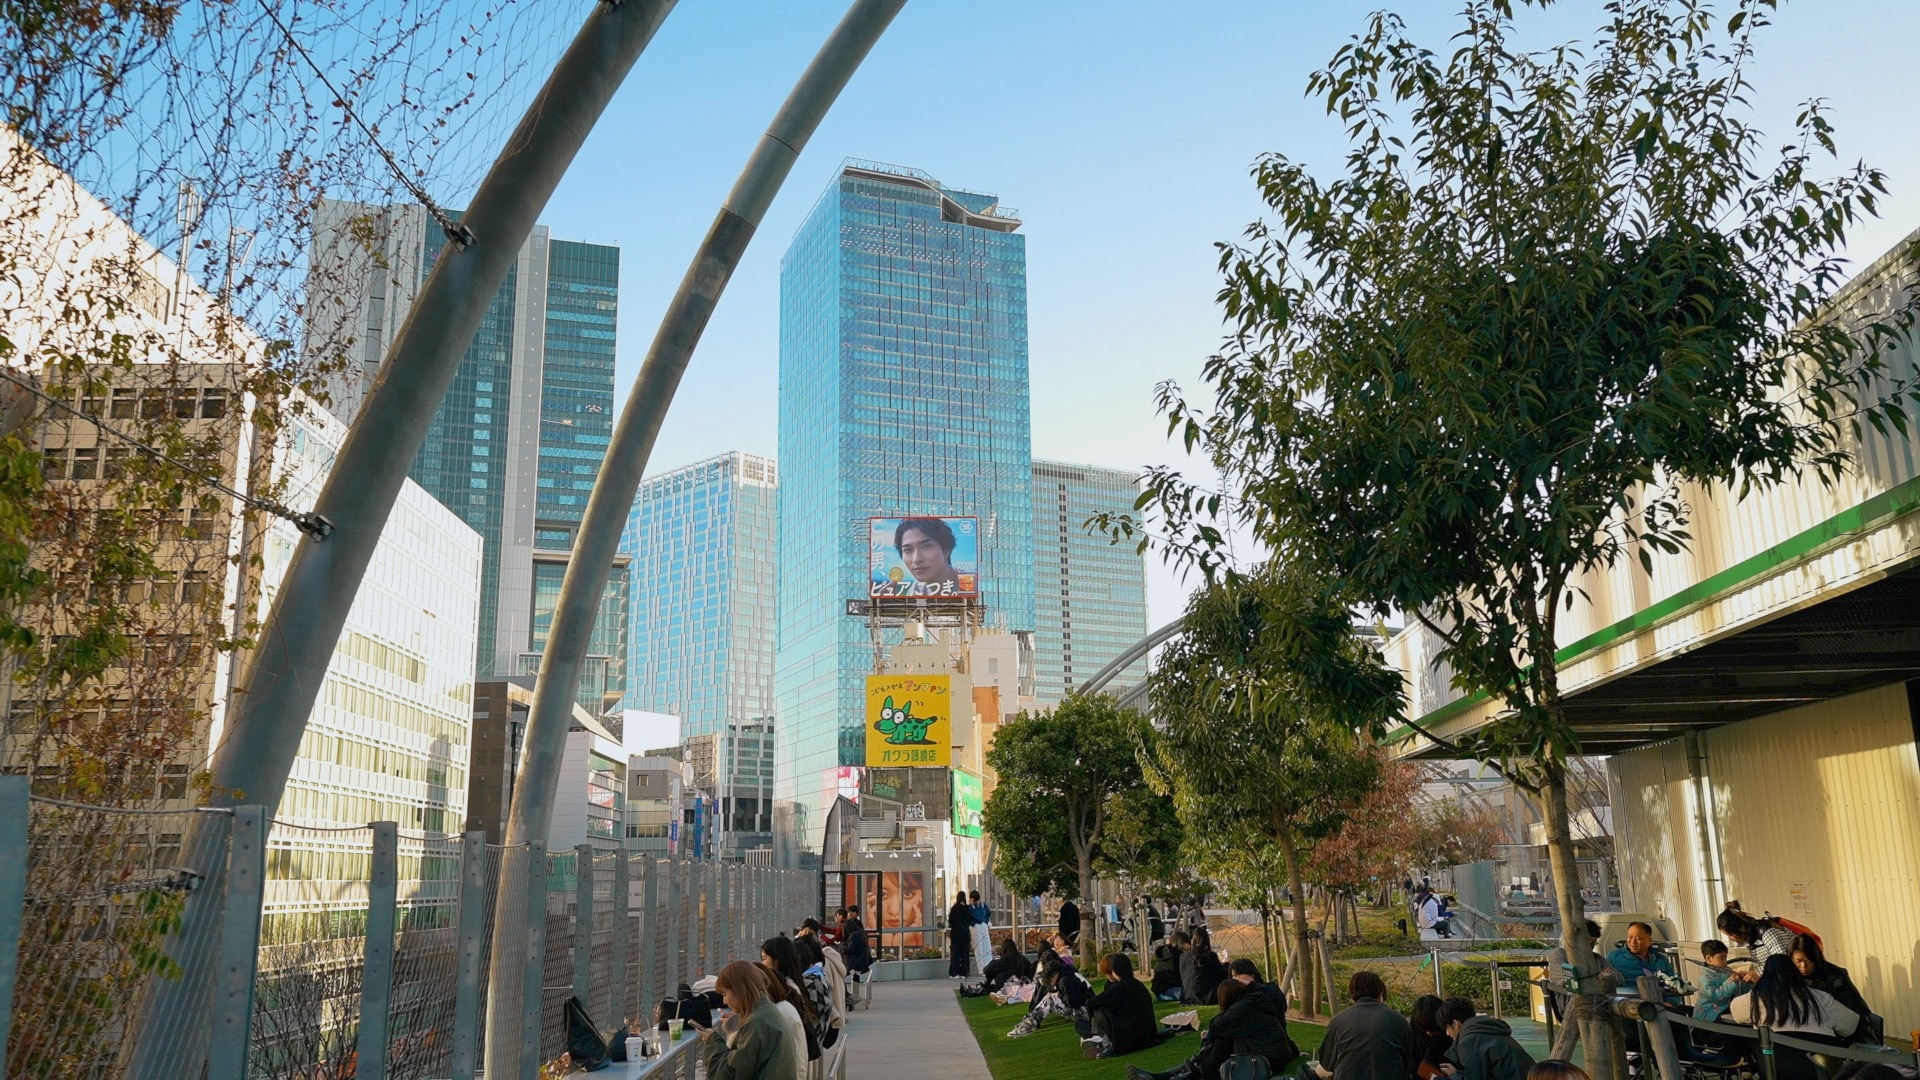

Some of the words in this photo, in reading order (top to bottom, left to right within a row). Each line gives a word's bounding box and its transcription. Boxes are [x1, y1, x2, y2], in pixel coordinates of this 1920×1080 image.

[870, 579, 958, 596] ピュアにつき。
[881, 749, 936, 762] オグラ眼鏡店
